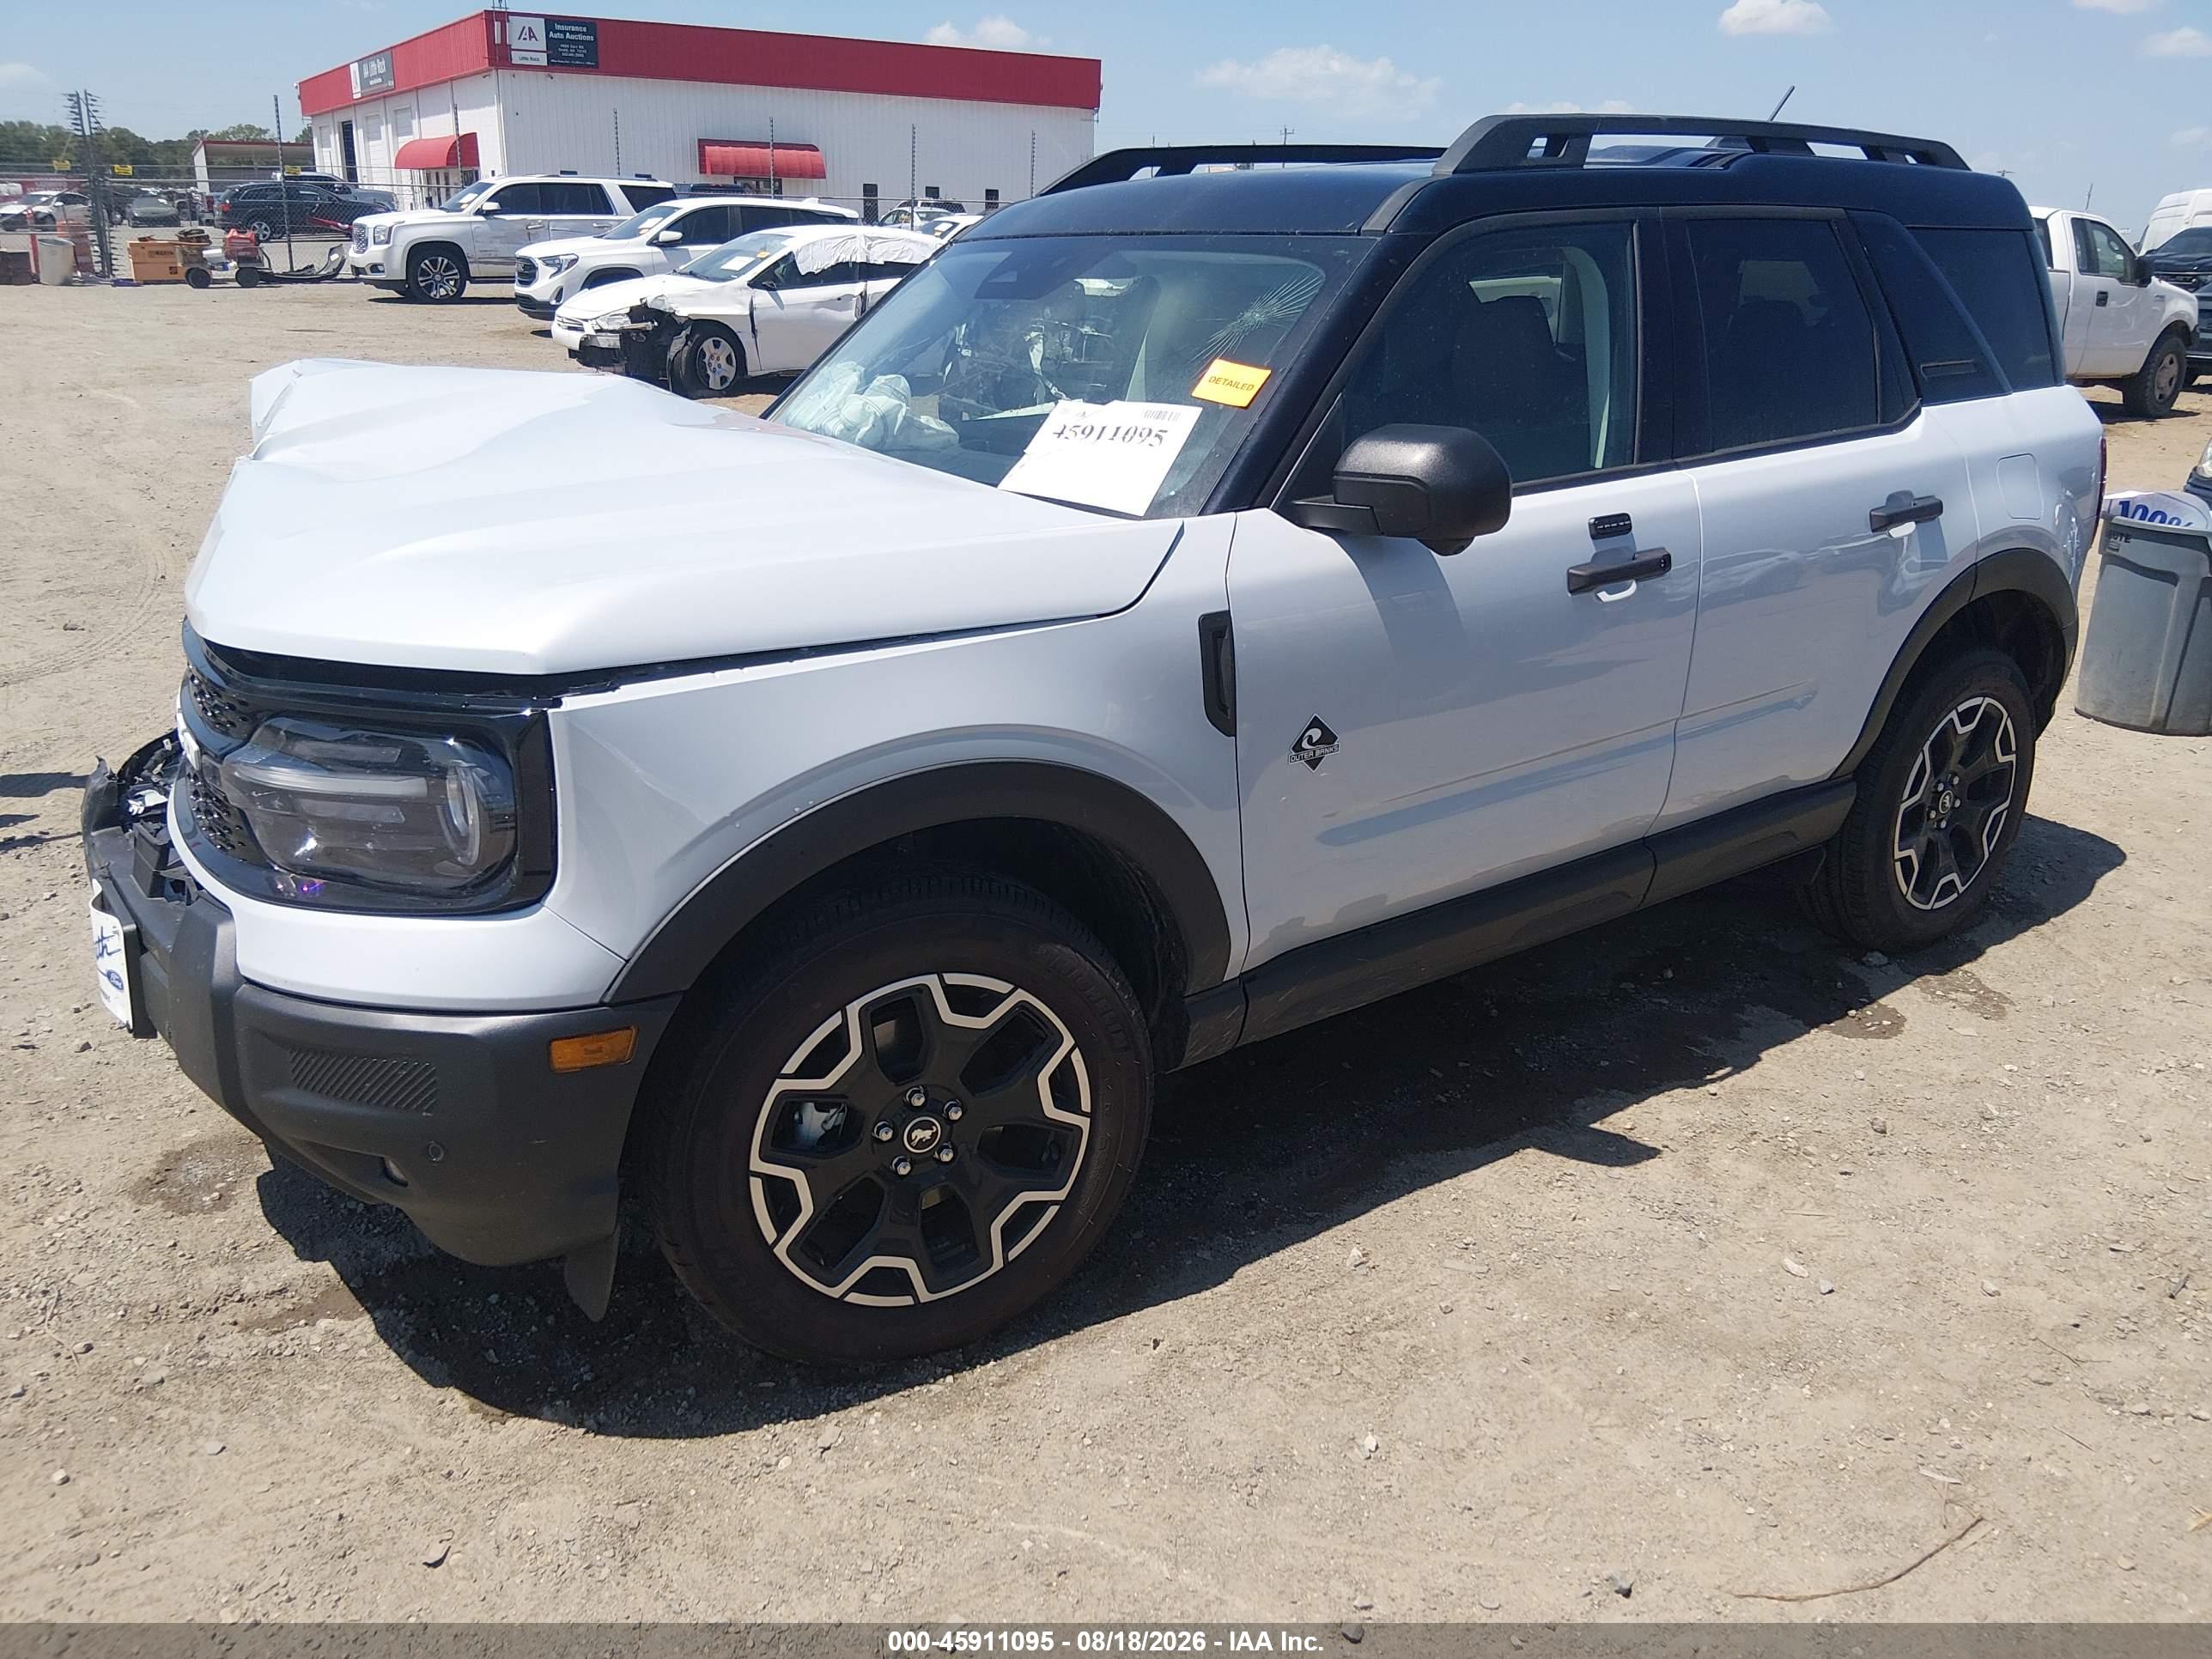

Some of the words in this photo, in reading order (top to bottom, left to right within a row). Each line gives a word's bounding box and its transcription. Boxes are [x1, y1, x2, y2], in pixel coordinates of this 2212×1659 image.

[555, 22, 587, 33] Insurance
[550, 31, 565, 40] Auto
[566, 33, 595, 41] Auctions
[1208, 376, 1255, 392] DETAILED
[1053, 423, 1168, 447] 45911095
[1291, 751, 1314, 763] OUTER
[1315, 745, 1339, 757] BANKS
